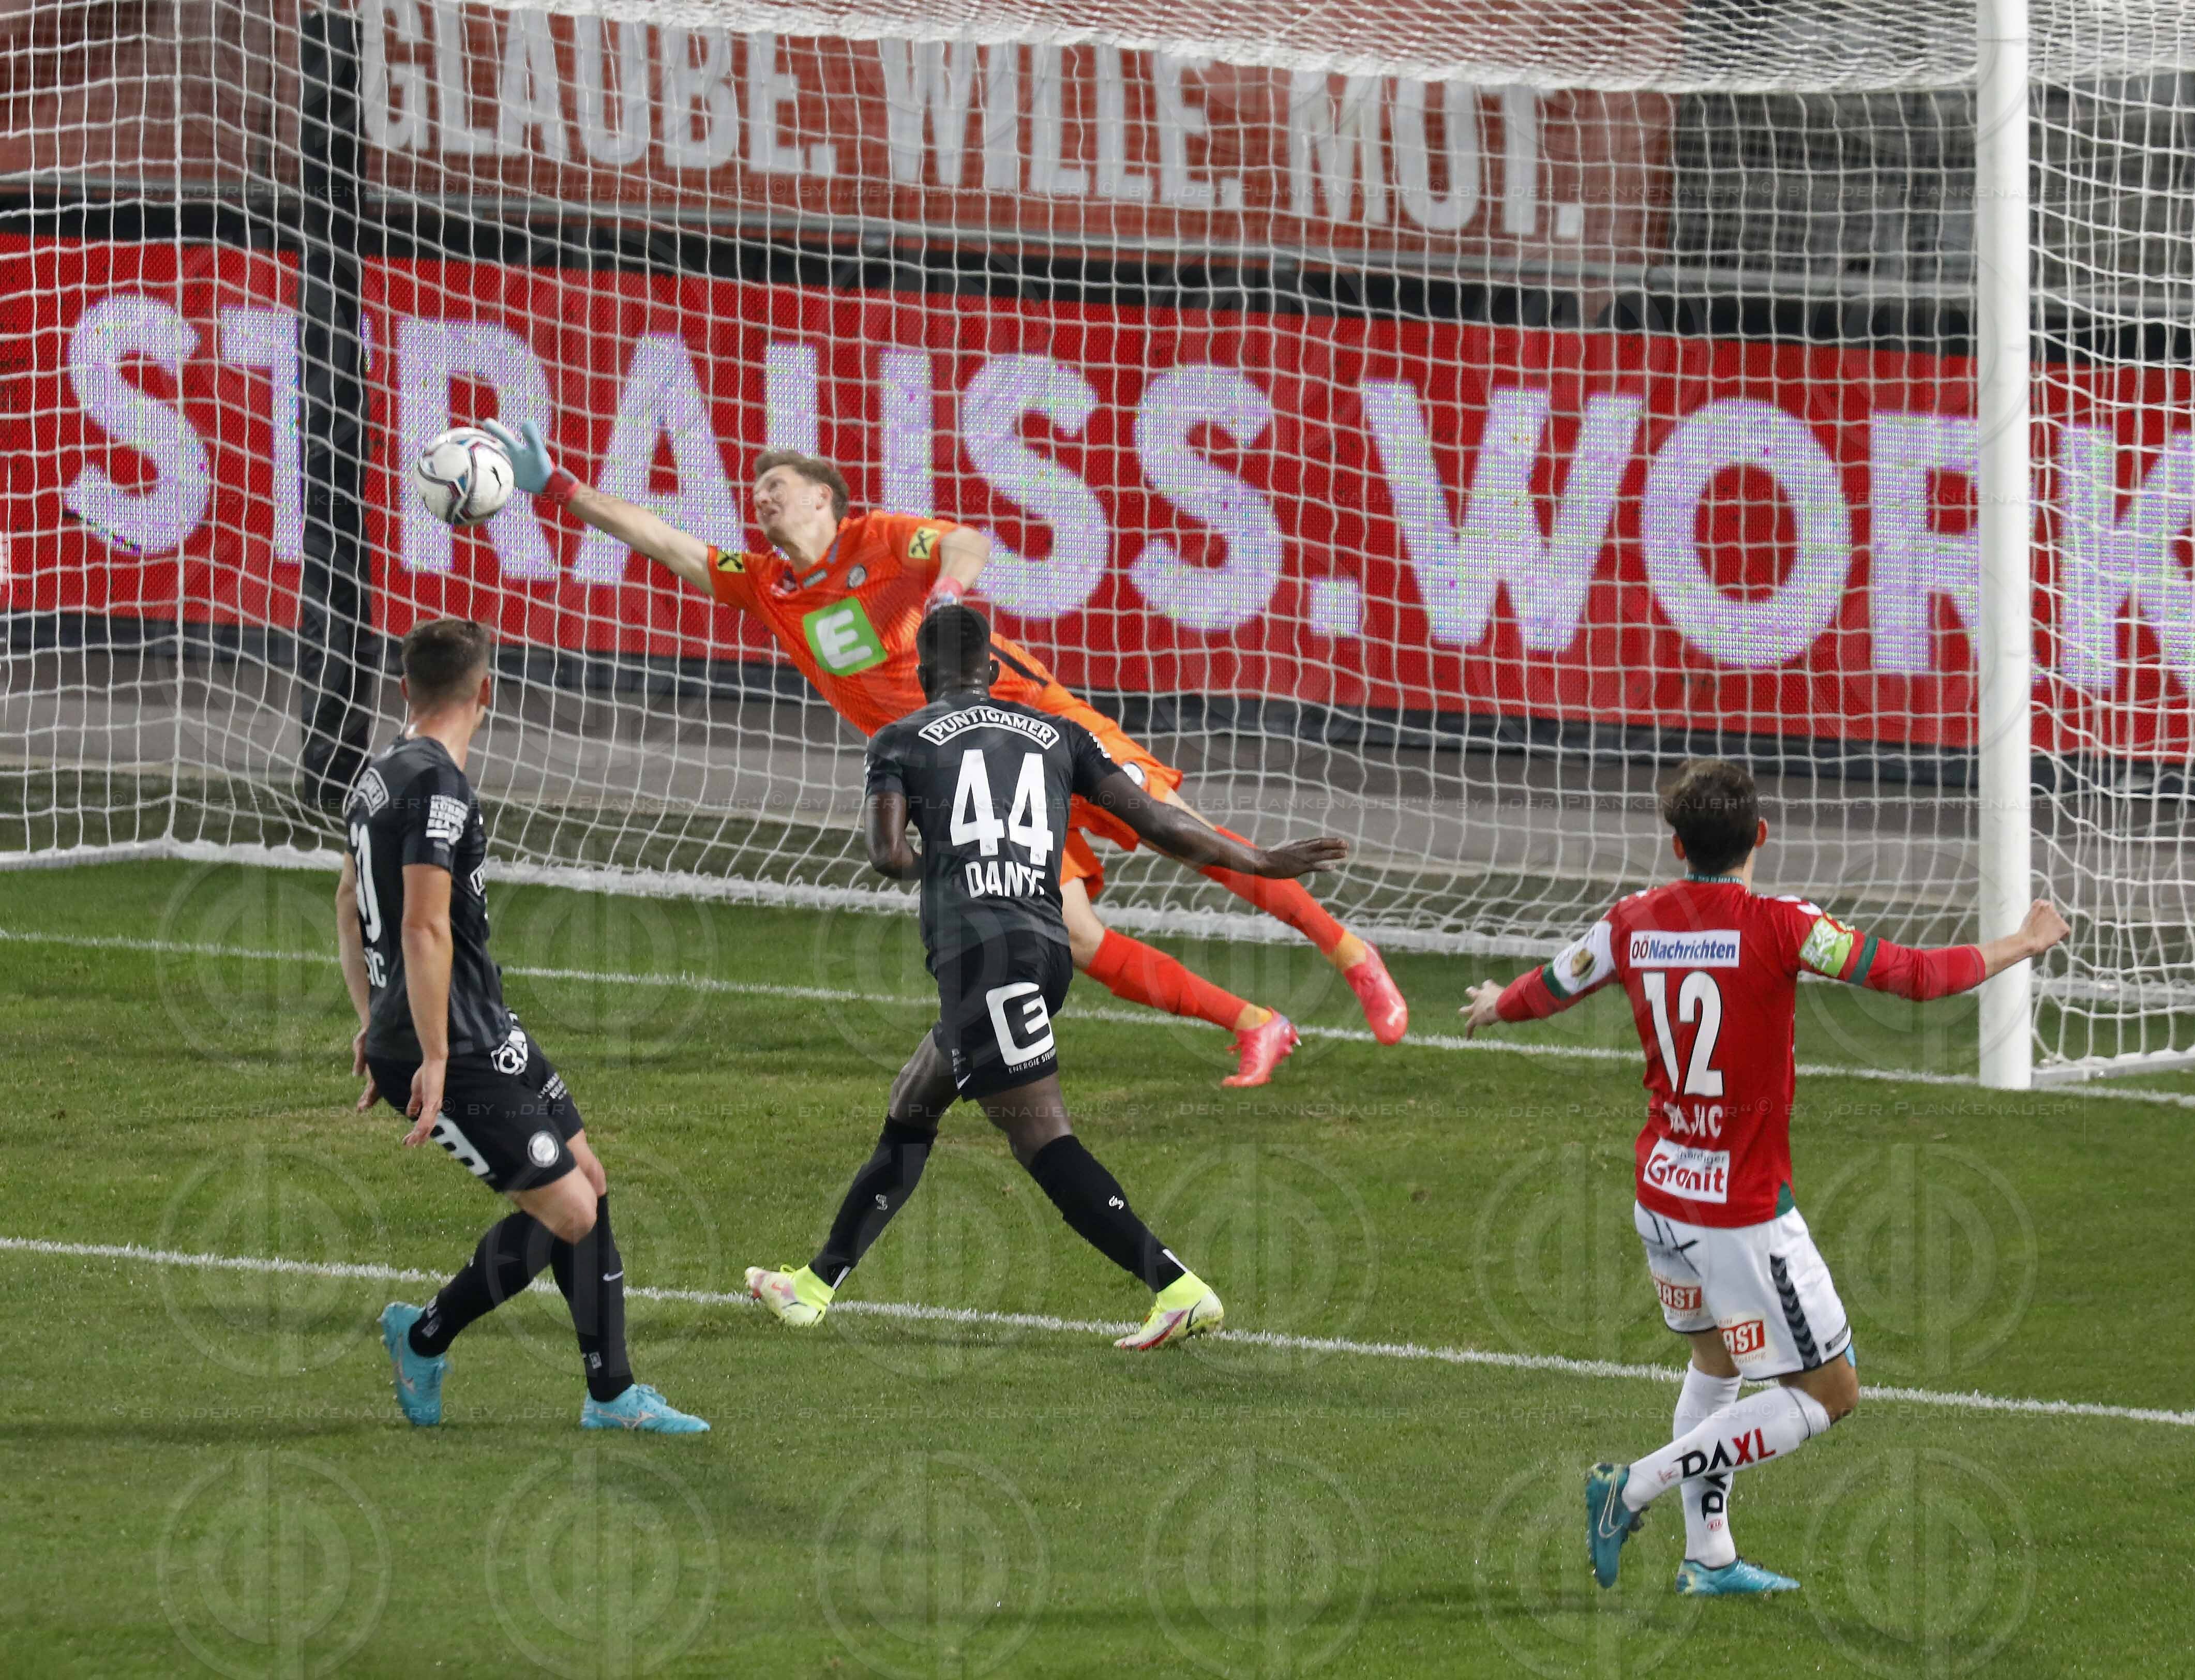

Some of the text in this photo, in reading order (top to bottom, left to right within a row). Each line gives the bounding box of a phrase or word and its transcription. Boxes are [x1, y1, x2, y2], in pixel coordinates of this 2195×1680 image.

[933, 709, 1053, 744] PUNTIGAMER
[950, 748, 1054, 866] 44
[1642, 970, 1724, 1097] 12
[1647, 1153, 1724, 1193] Granit
[1673, 1427, 1776, 1478] DAXL
